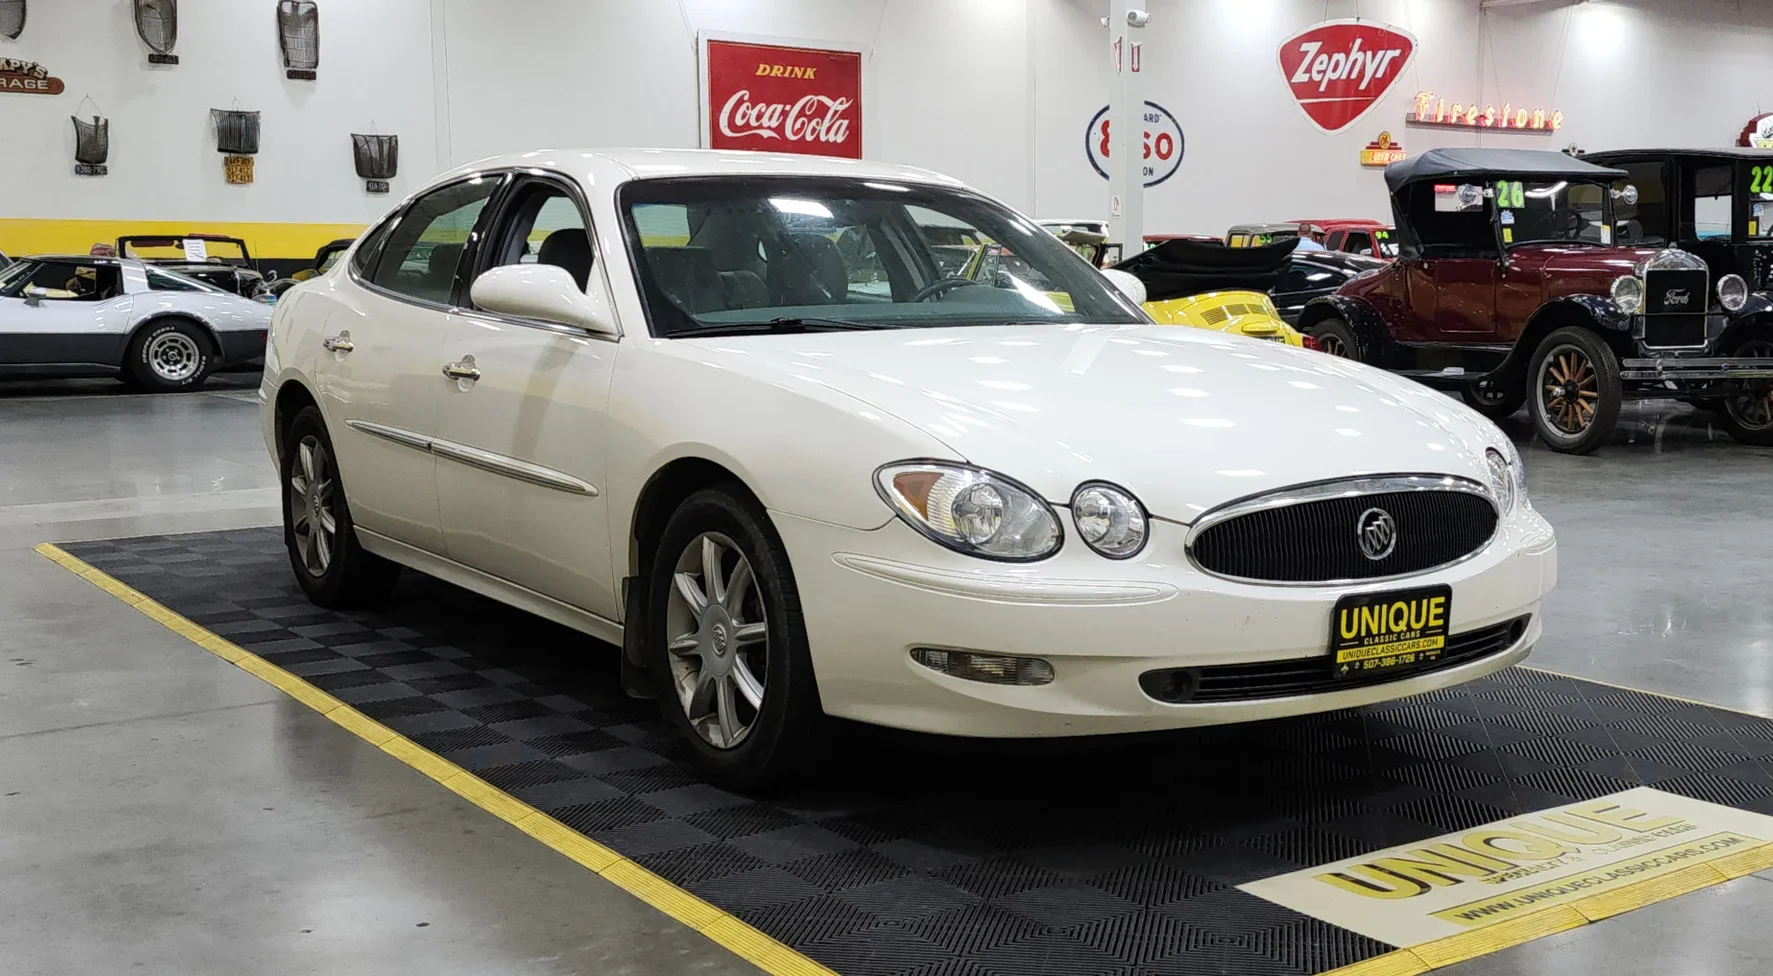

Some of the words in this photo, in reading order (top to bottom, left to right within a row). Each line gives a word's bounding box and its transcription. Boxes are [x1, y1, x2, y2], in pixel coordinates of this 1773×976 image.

[755, 63, 817, 80] DRINK
[1290, 38, 1402, 92] Zephyr
[719, 89, 854, 143] Coca-Cola
[1414, 90, 1563, 130] Firestone
[1750, 165, 1772, 193] 22
[1497, 180, 1524, 208] 26
[1663, 288, 1690, 306] Ford
[1341, 596, 1445, 639] UNIQUE
[1342, 638, 1438, 660] UNIQUECLASSICCARS.COM
[1364, 634, 1398, 645] CLASSIC
[1400, 630, 1421, 640] CARS
[1363, 653, 1416, 669] 507-386-1726
[1311, 801, 1686, 899] UNIQUE
[1454, 836, 1745, 921] WWW.UNIQUECLASSICCARS.COM
